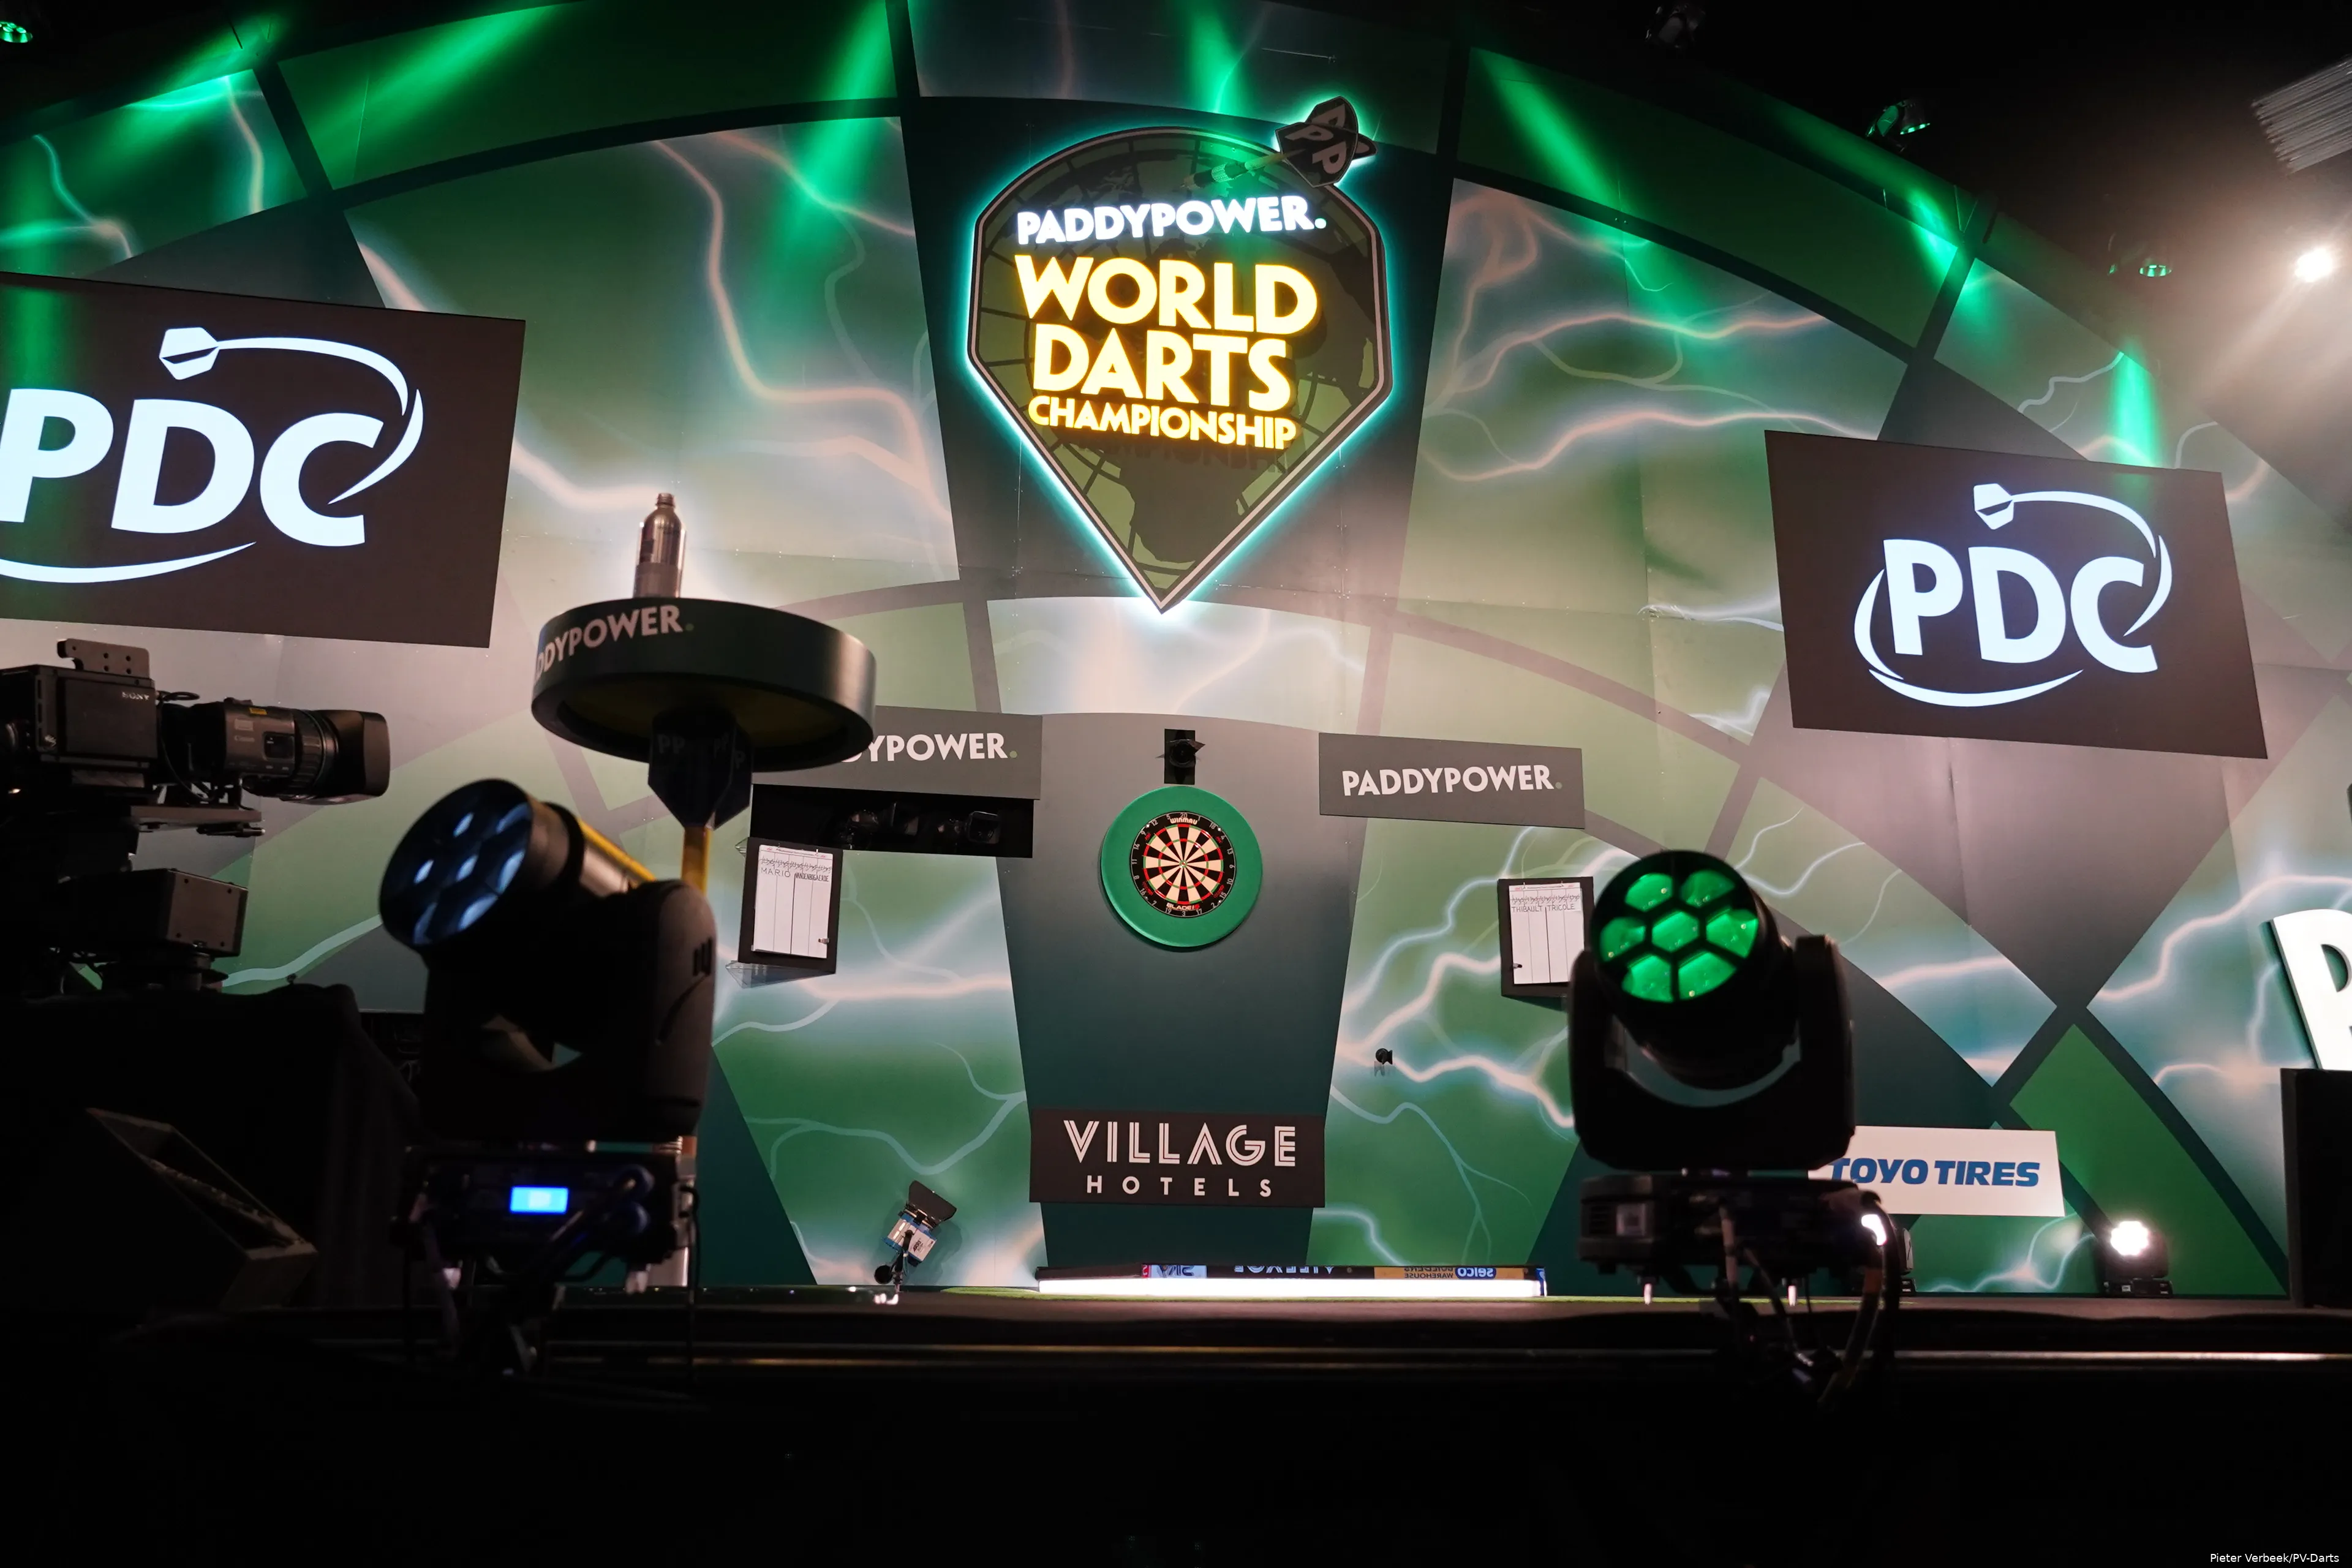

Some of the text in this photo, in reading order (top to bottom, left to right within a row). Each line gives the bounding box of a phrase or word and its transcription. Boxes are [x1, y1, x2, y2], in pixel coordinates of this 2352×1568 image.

[1014, 255, 1317, 335] WORLD
[1033, 323, 1292, 412] DARTS
[1028, 395, 1297, 450] CHAMPIONSHIP
[0, 388, 384, 547] PDC
[1883, 539, 2158, 673] PDC
[761, 867, 791, 878] MARIO
[1063, 1120, 1296, 1167] VILLAGE
[1087, 1175, 1272, 1197] HOTELS
[1828, 1158, 2040, 1187] TOYO TIRES
